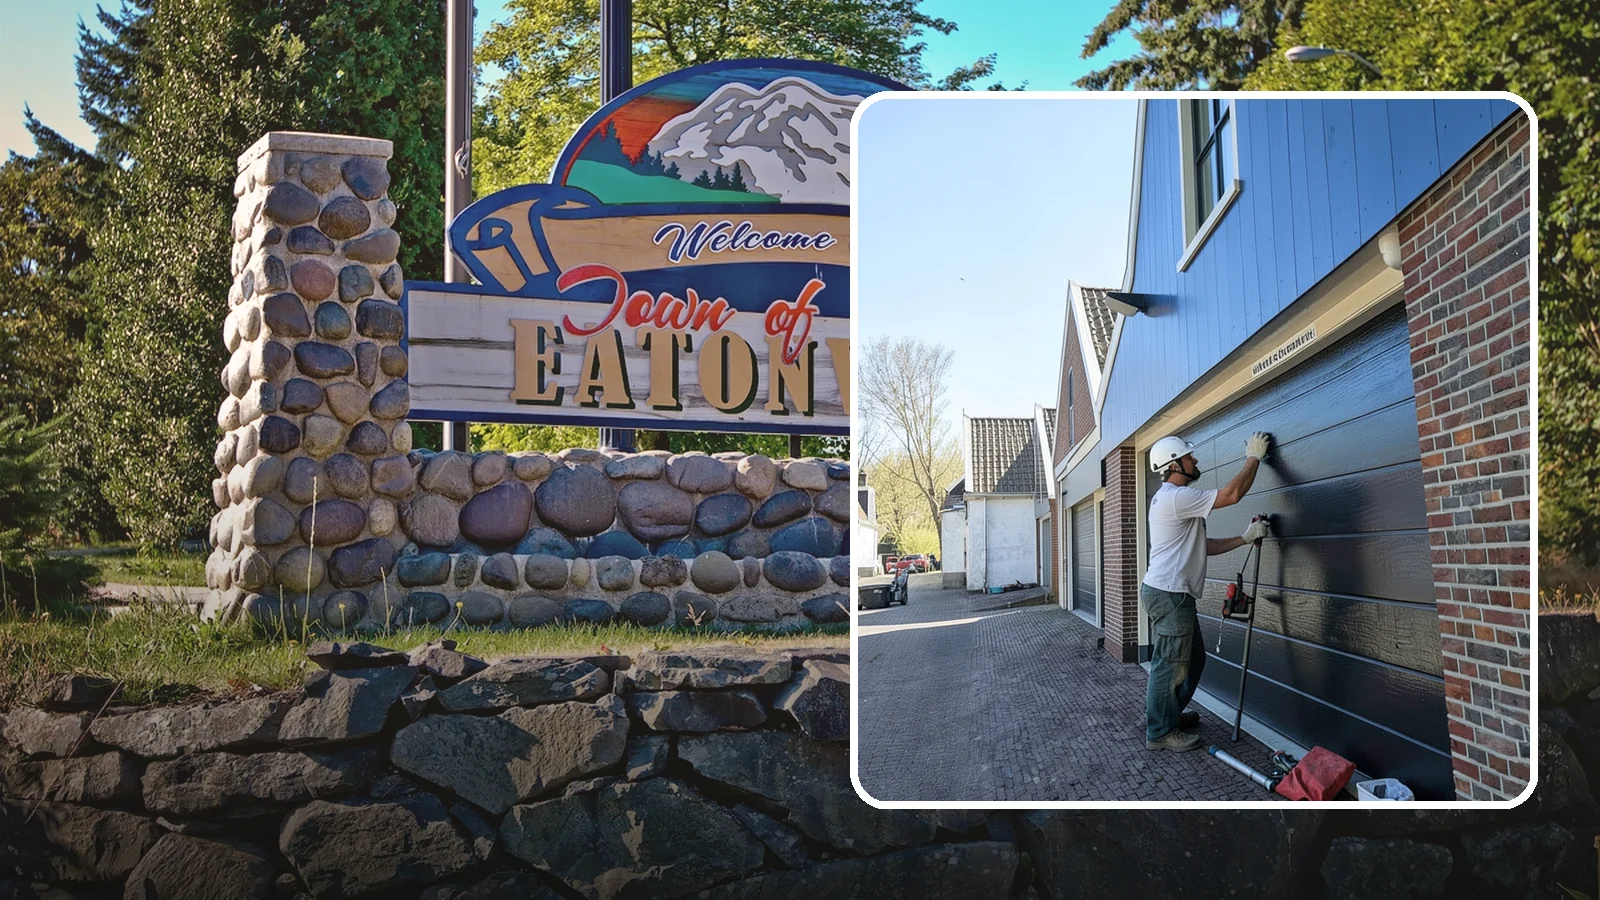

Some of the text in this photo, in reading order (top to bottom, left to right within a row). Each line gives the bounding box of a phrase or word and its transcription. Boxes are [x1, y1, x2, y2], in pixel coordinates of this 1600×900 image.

[653, 220, 838, 263] Welcome
[556, 263, 826, 365] Town of
